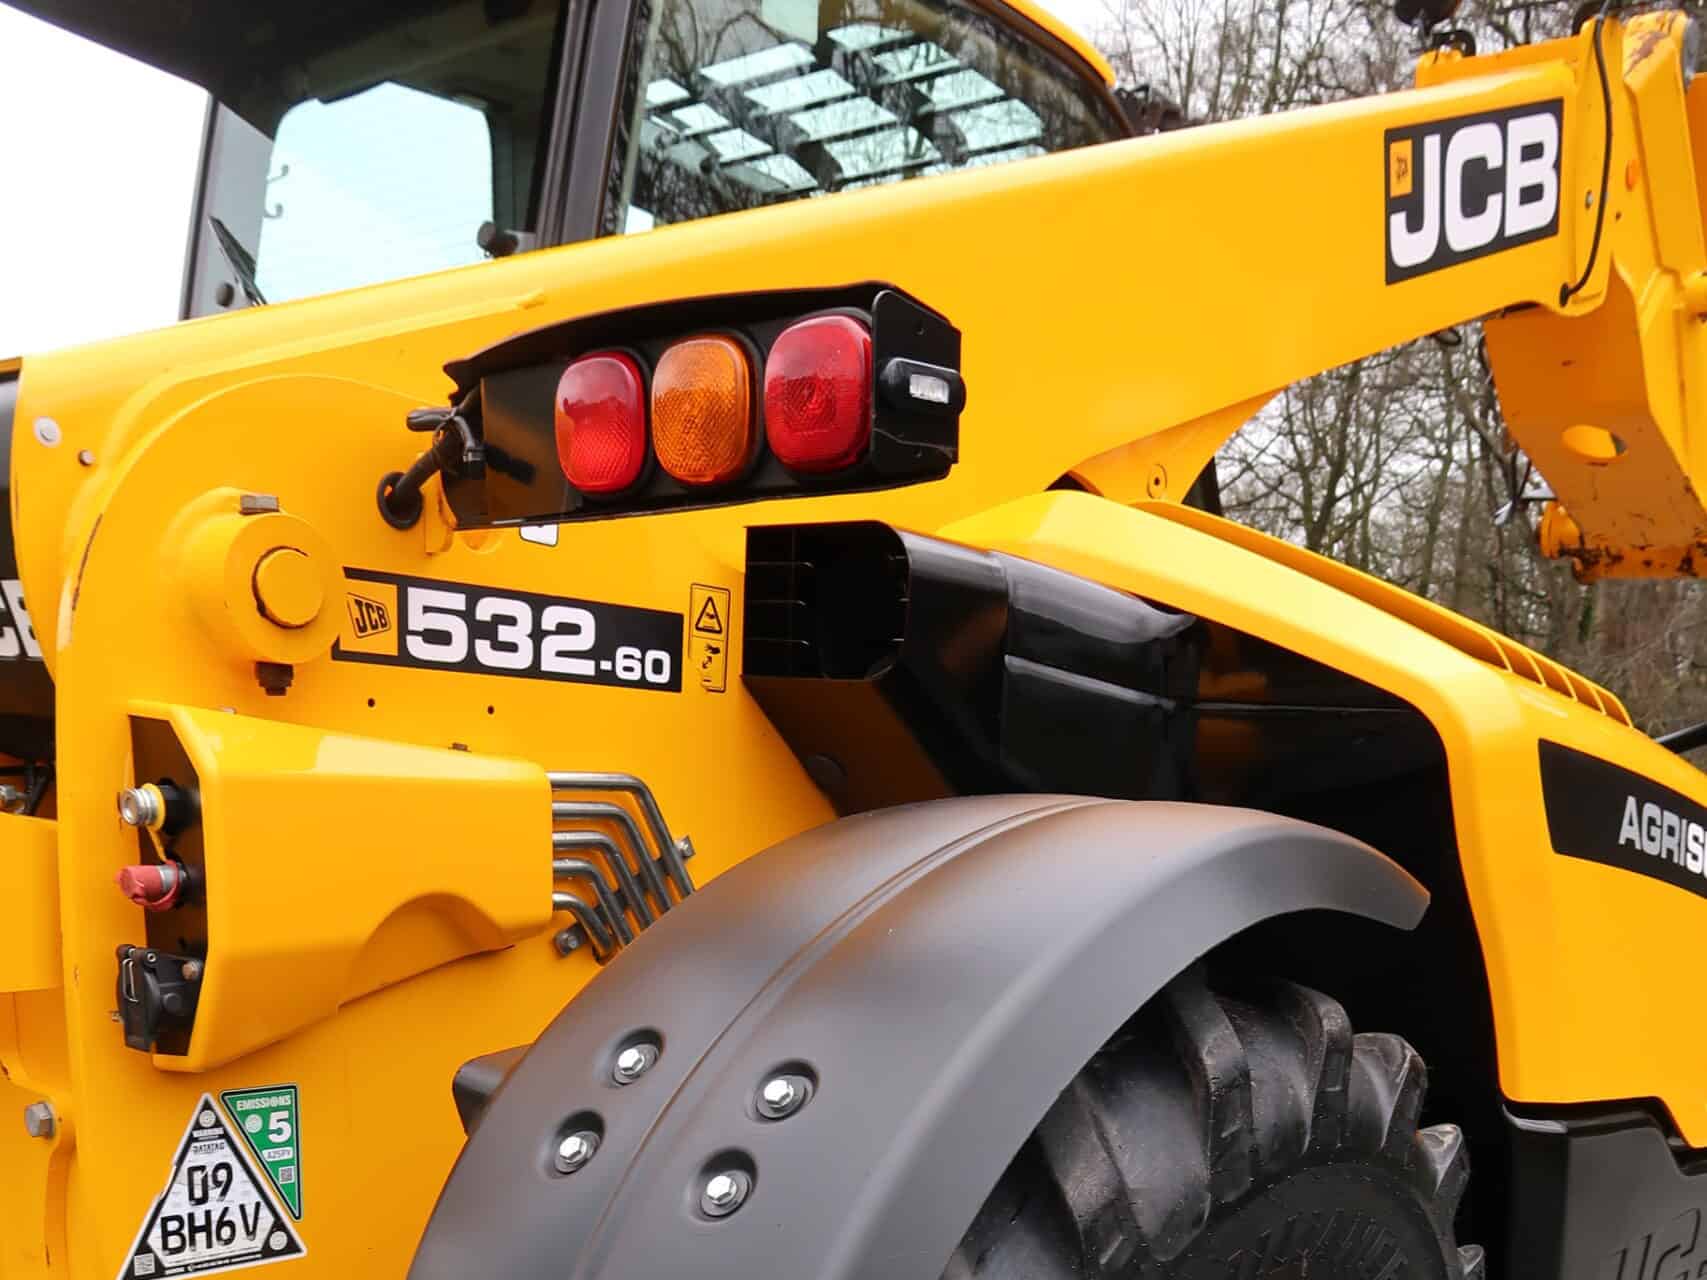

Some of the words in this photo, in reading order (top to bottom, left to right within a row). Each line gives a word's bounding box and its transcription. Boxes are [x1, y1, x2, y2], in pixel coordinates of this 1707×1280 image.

[1390, 112, 1559, 268] JCB
[354, 598, 390, 634] JCB
[405, 586, 672, 685] 532-60
[1618, 795, 1707, 880] AGRIS
[267, 1111, 292, 1143] 5
[160, 1201, 261, 1257] BH6V
